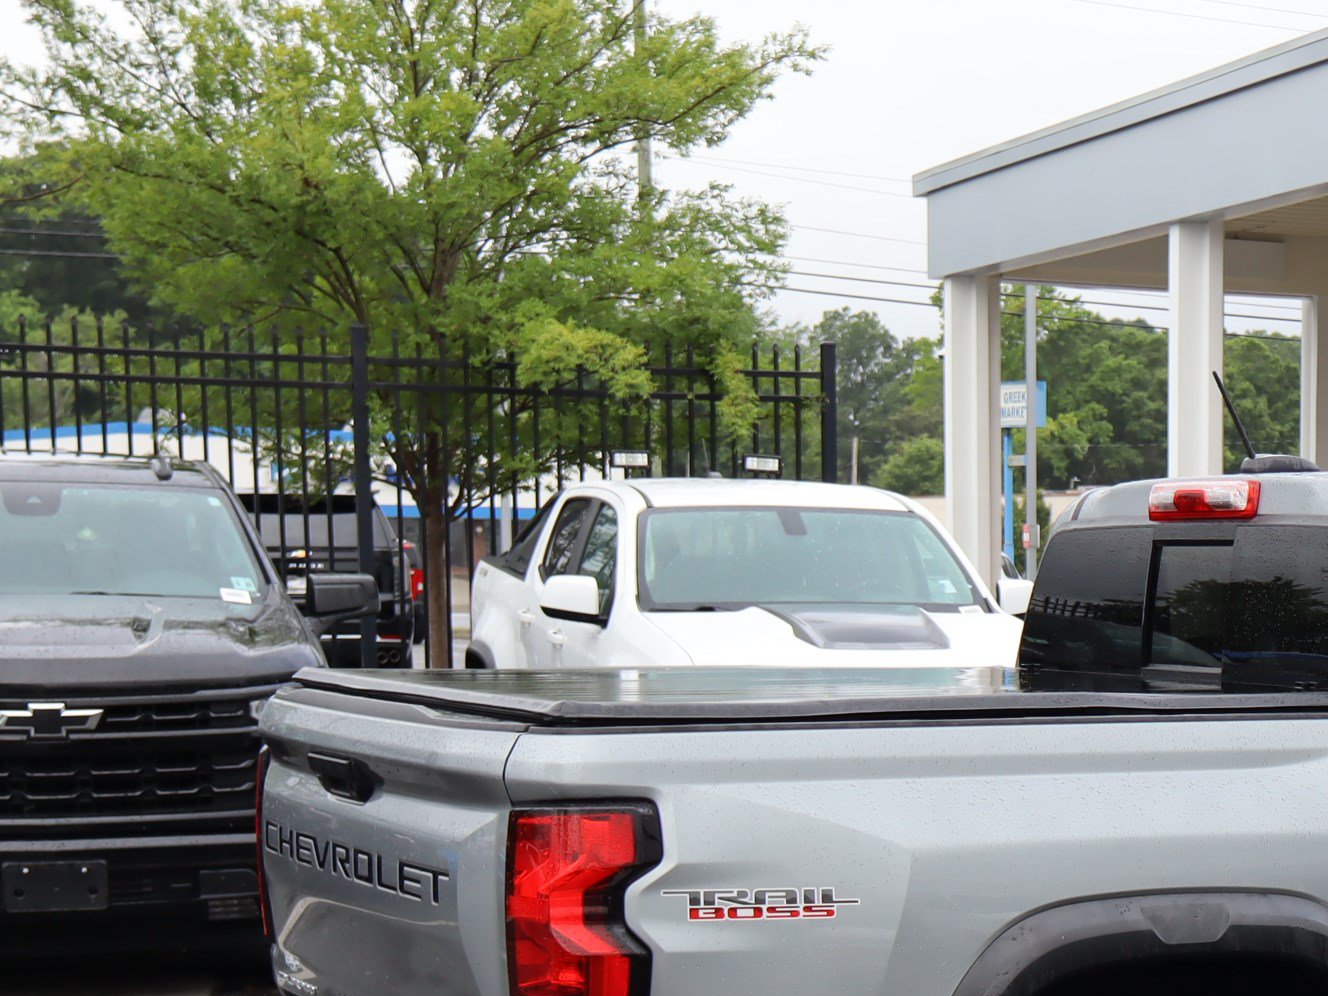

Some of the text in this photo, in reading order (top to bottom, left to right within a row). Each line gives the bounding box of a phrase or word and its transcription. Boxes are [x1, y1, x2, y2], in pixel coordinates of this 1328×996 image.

[265, 819, 450, 906] CHEVROLET
[660, 887, 860, 906] TRAIL
[688, 905, 837, 922] BOSS
